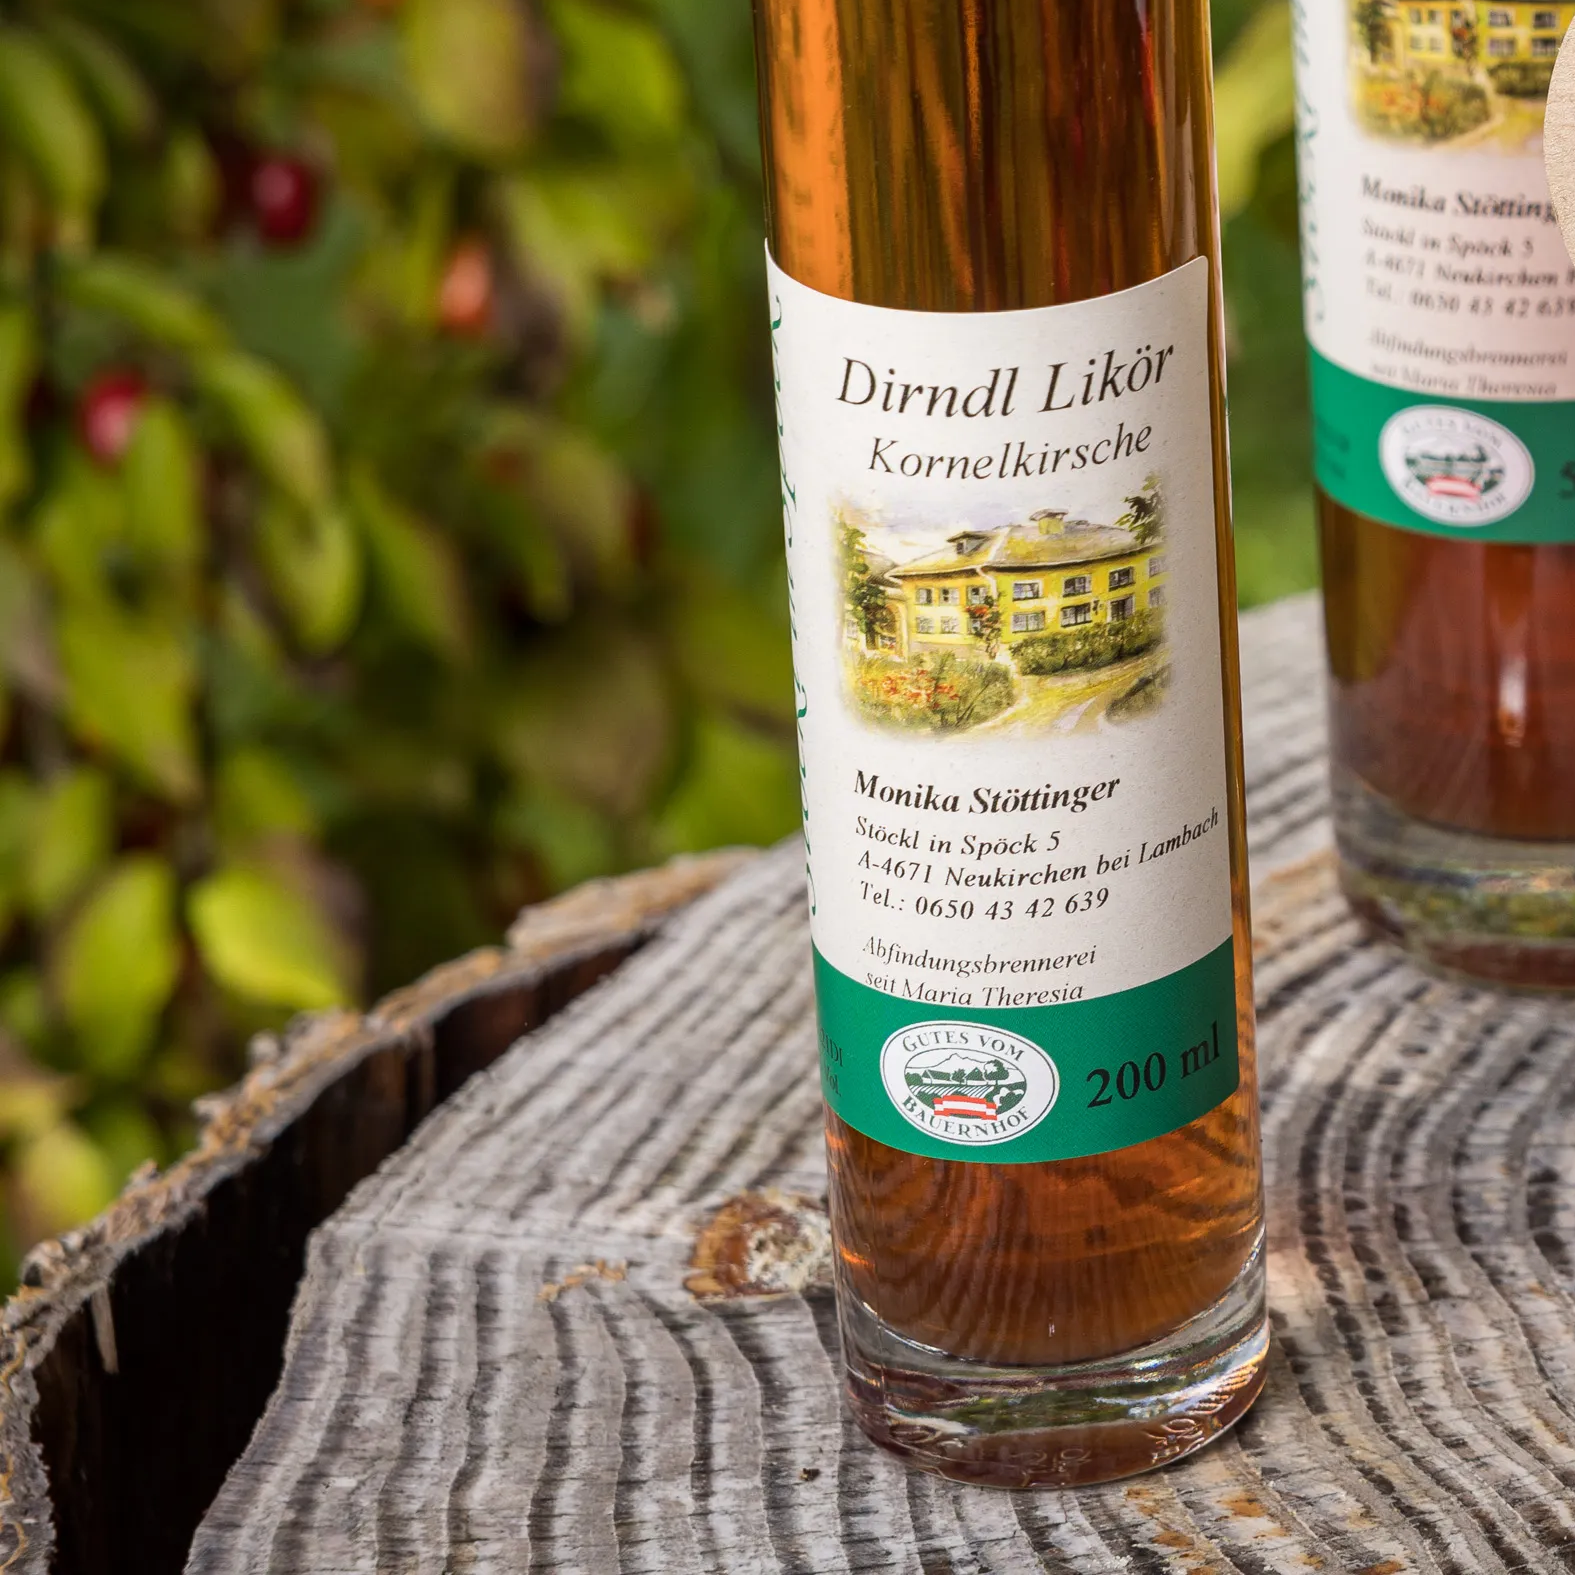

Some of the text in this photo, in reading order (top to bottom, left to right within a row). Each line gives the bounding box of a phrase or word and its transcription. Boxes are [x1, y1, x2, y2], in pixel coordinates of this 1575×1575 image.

[1361, 174, 1557, 225] Monika Stötting
[836, 343, 1175, 419] Dirndl Likör
[868, 423, 1152, 480] Kornelkirsche
[854, 769, 1121, 815] Monika Stöttinger
[856, 815, 1061, 861] Stöckl in Spöck 5
[858, 806, 1219, 888] A-4671 Neukirchen bei Lambach
[860, 880, 1110, 922] Tel.: 0650 43 42 639
[863, 936, 1097, 978] Abfindungsbrennerei
[865, 972, 1084, 1007] seit Maria Theresia
[902, 1030, 1025, 1061] GUTES VOM
[1086, 1020, 1220, 1109] 200 ml
[901, 1094, 1031, 1139] BAUERNHOF
